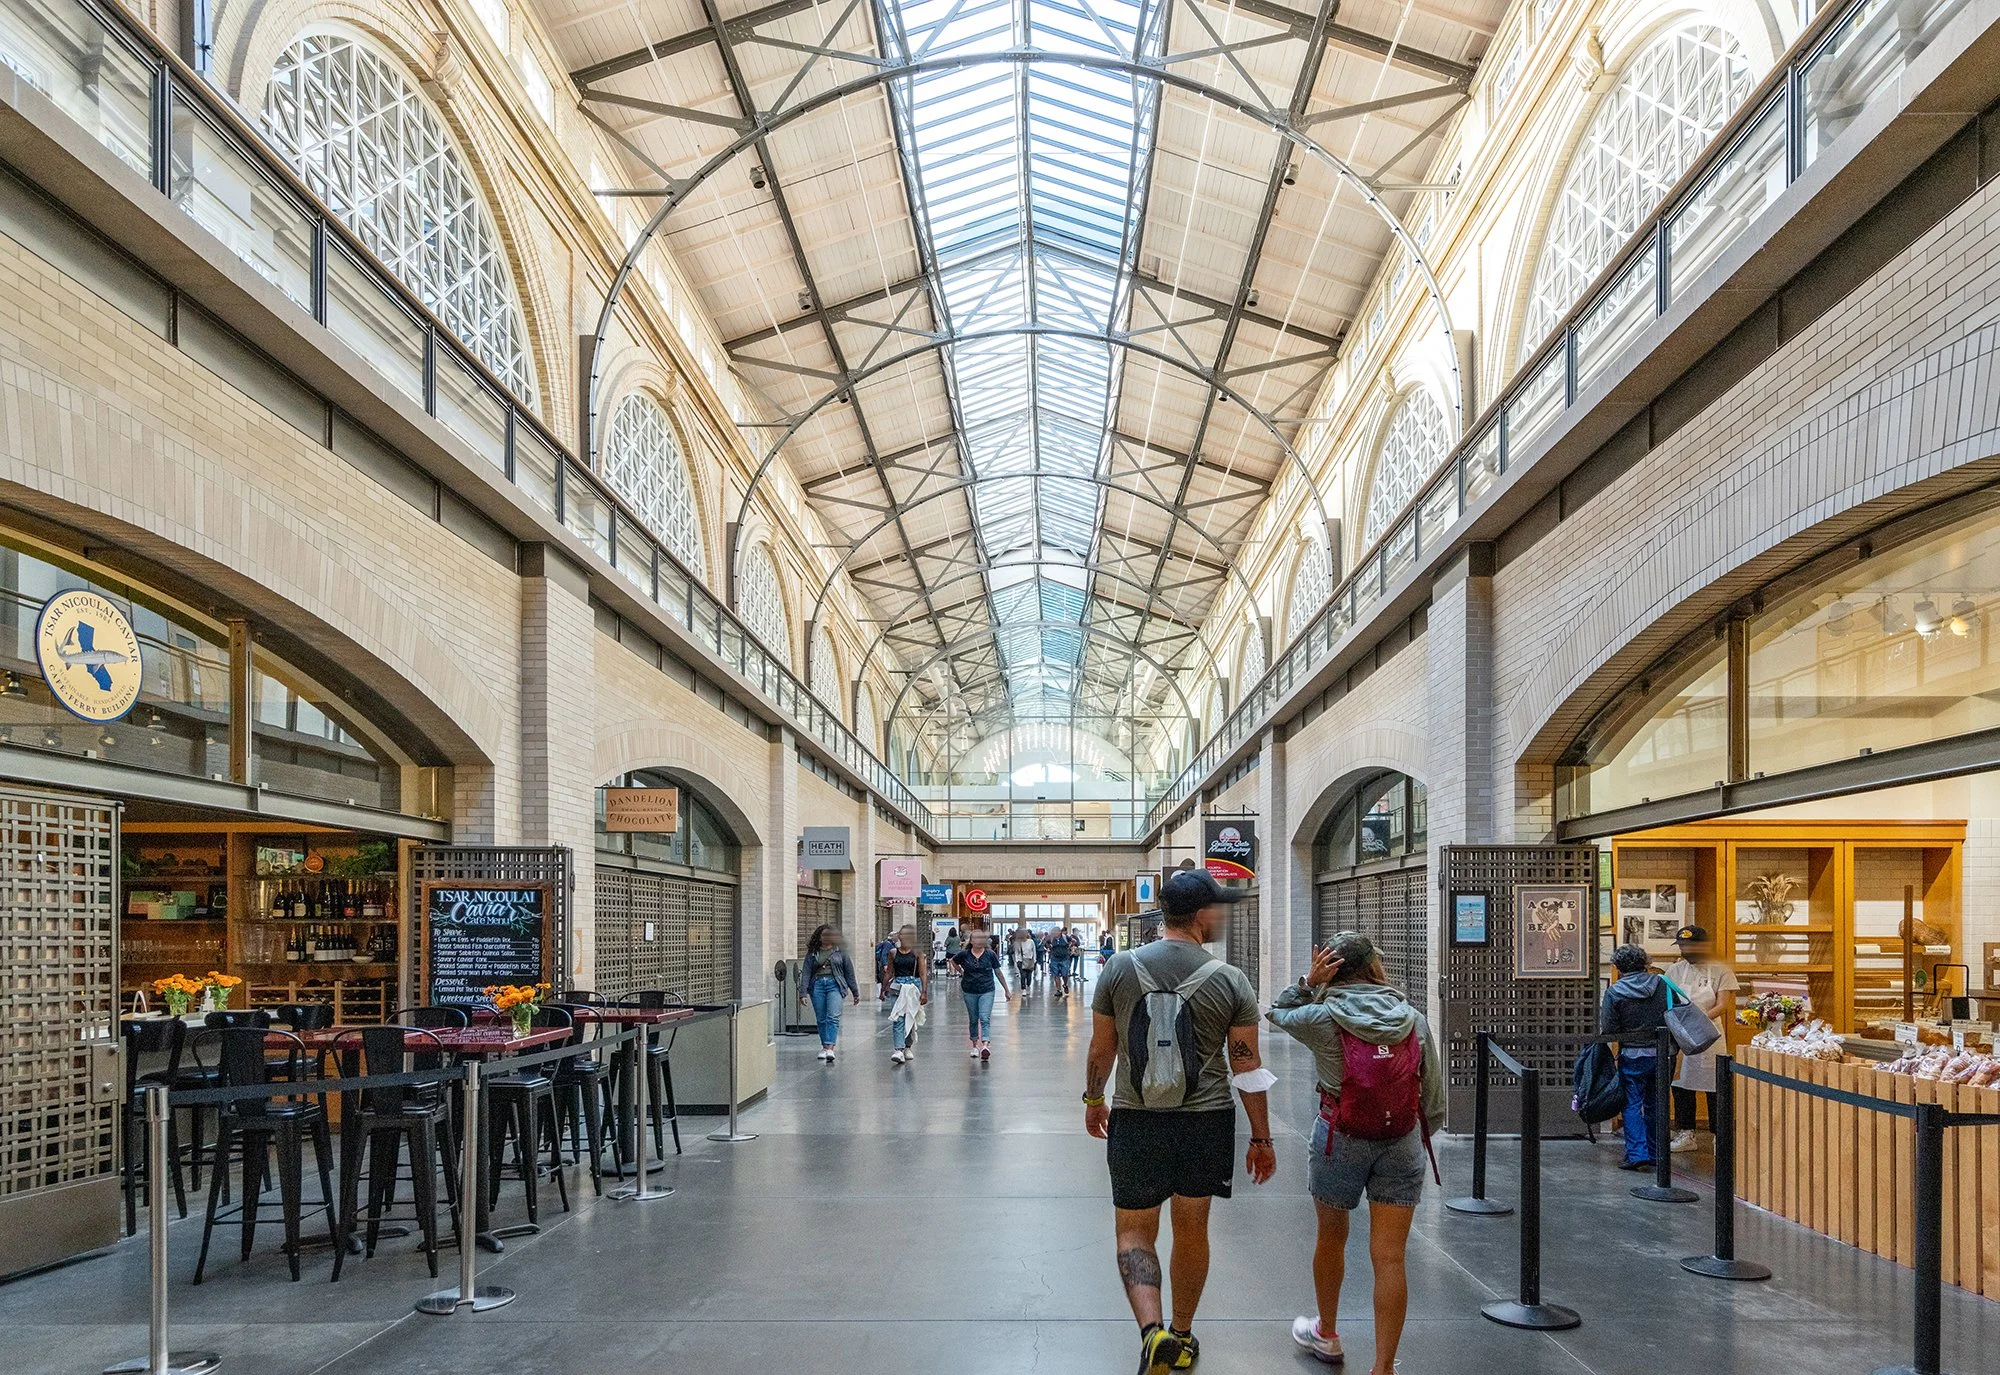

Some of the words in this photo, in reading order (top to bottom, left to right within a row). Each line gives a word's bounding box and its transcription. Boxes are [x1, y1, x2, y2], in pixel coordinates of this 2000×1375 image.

[45, 607, 64, 638] TSAR
[62, 596, 114, 618] NICOULAI
[115, 618, 138, 663] CAVIAR
[68, 694, 98, 714] FERRY
[102, 686, 134, 714] BUILDING
[610, 794, 674, 807] DANDELION
[610, 812, 674, 825] CHOCOLATE
[437, 890, 470, 902] TSAR
[472, 890, 536, 903] NICOULAI
[1528, 900, 1576, 908] ACME
[451, 899, 518, 923] Caviar
[440, 994, 475, 1003] Weekend
